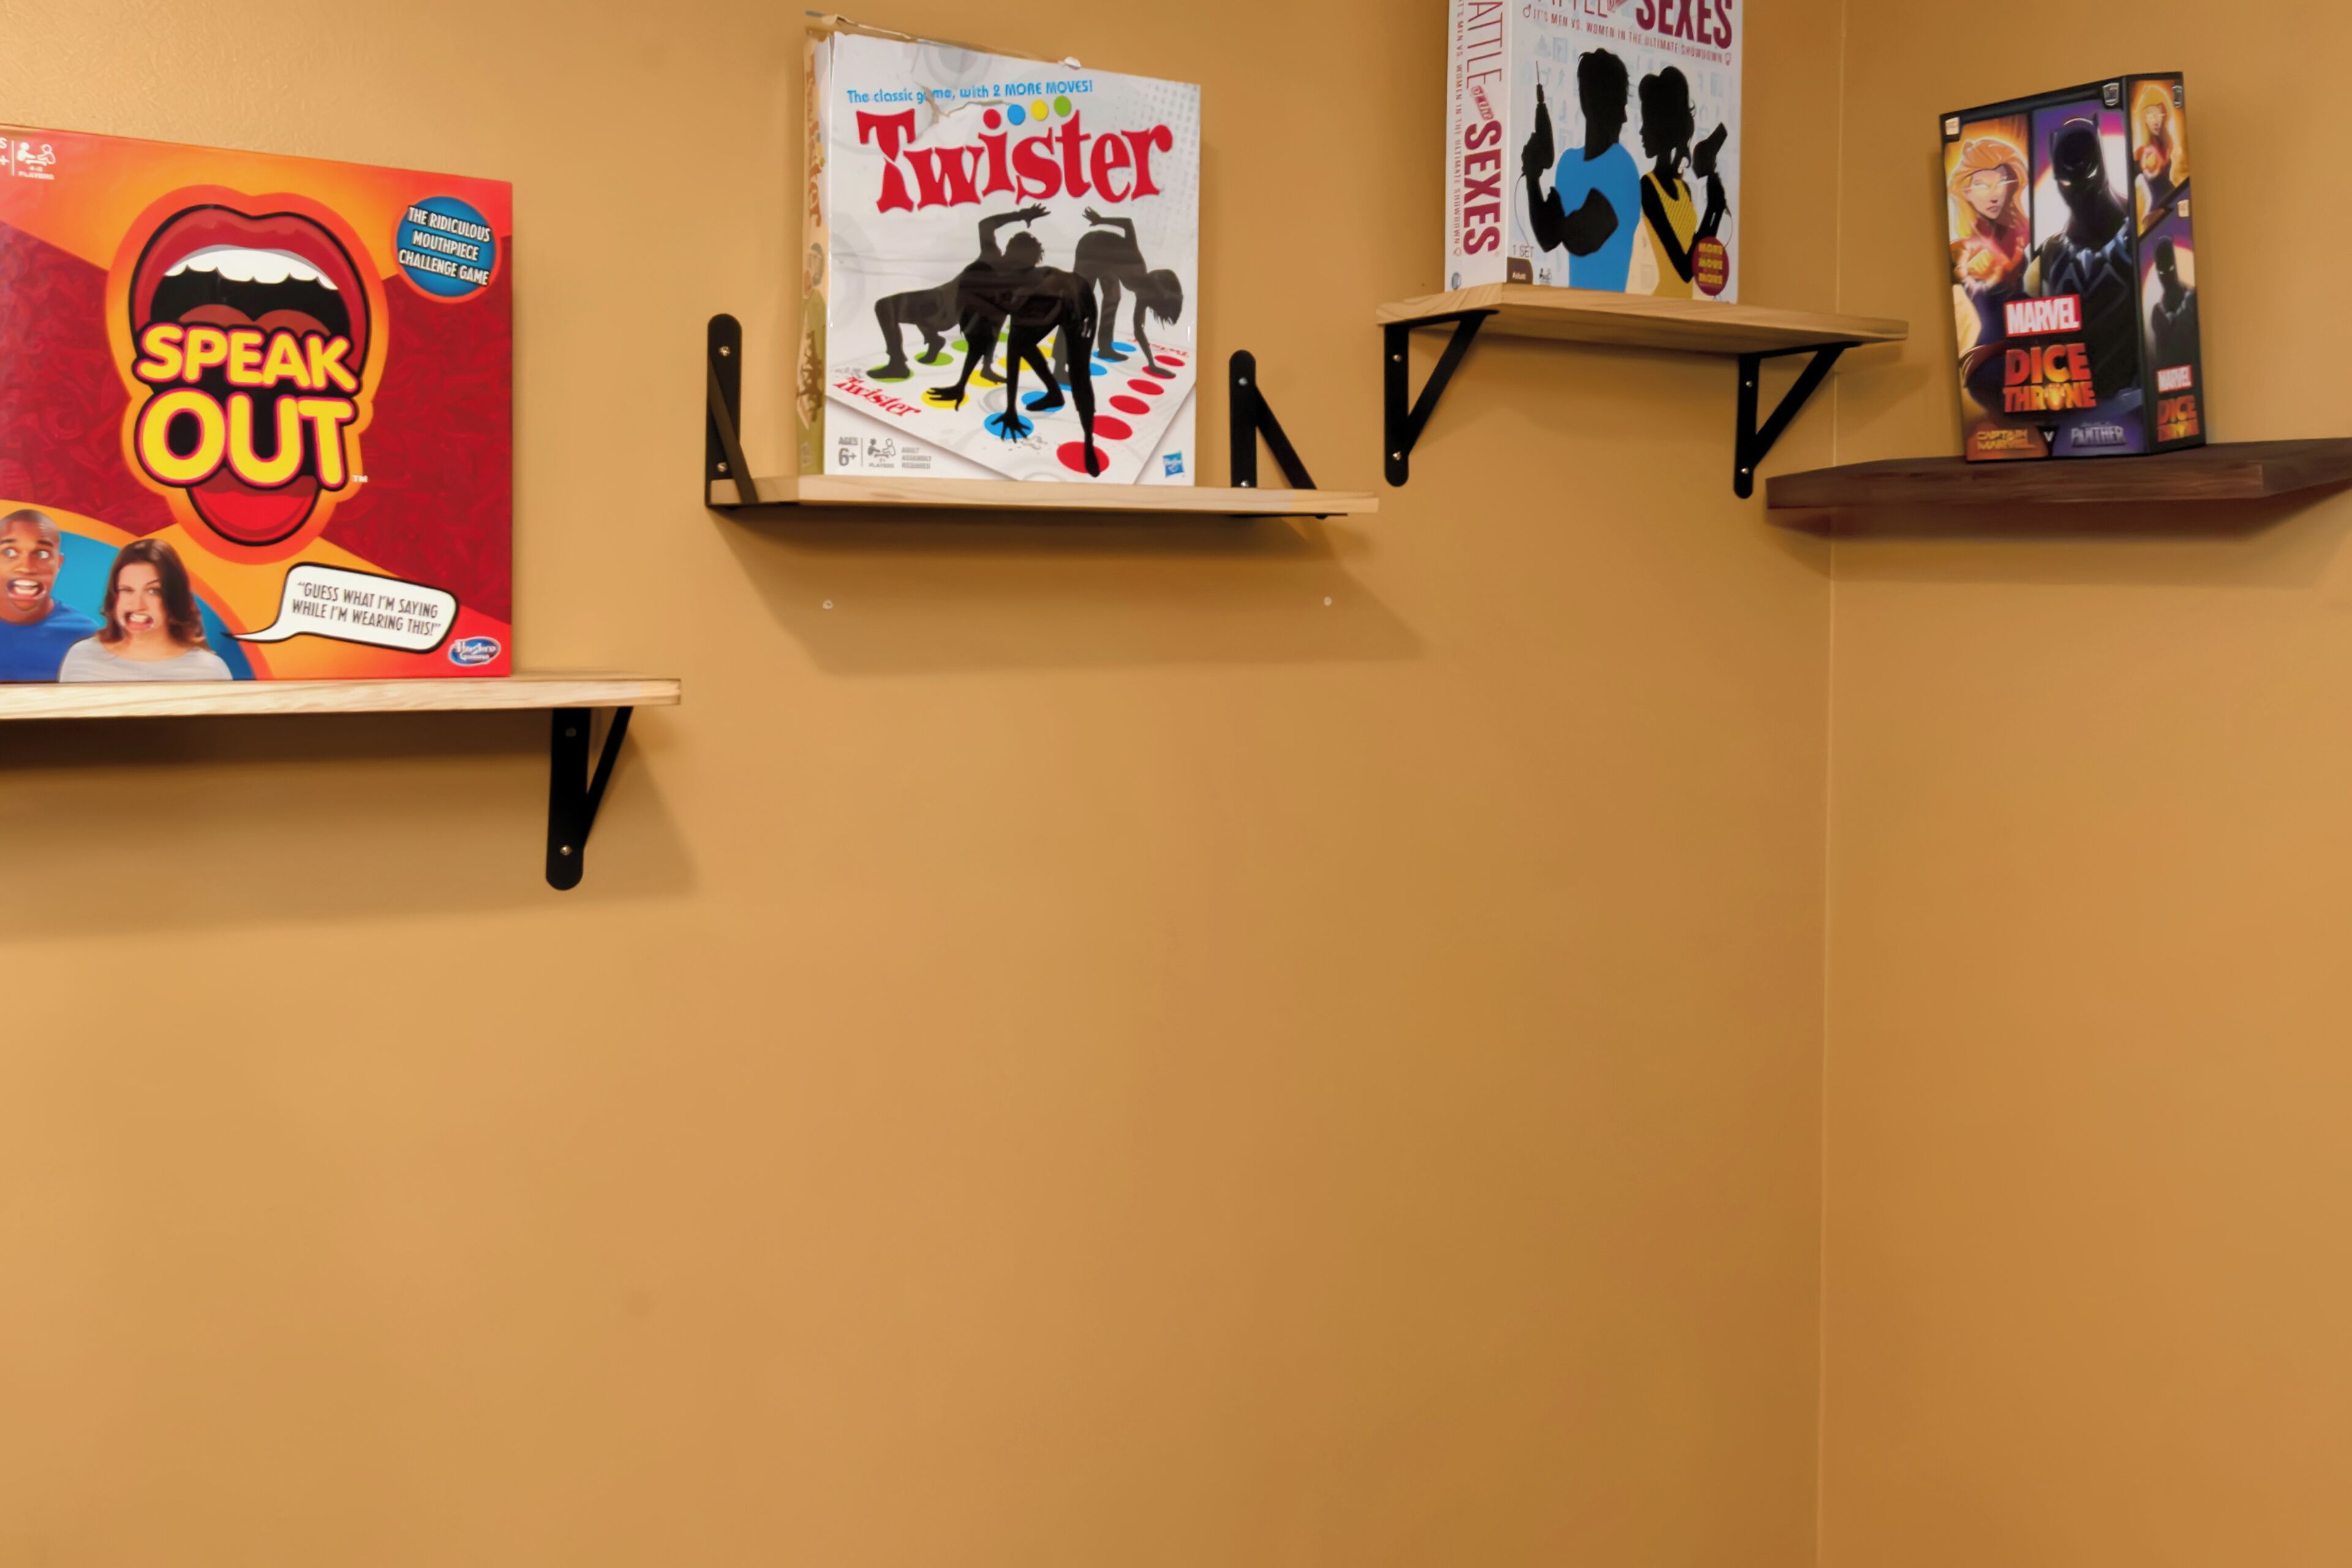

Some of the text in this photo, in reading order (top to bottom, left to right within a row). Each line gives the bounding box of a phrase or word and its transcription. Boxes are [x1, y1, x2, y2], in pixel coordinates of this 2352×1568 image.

[1533, 9, 1548, 22] IT'S
[1551, 13, 1568, 27] MEN
[1586, 21, 1615, 38] WOMEN
[1618, 29, 1626, 41] IN
[1629, 31, 1642, 44] THE
[1645, 36, 1678, 53] ULTIMATE
[1681, 44, 1722, 64] SHOWDOWN
[1636, 0, 1732, 49] SEXES
[1467, 0, 1503, 89] ATTLE
[847, 89, 869, 104] The
[874, 88, 913, 103] classic
[959, 84, 989, 99] with
[993, 84, 1001, 97] 2
[1005, 81, 1042, 97] MORE
[1046, 80, 1093, 94] MOVES!
[1455, 104, 1463, 115] IN
[856, 108, 1174, 214] Twister
[1463, 120, 1502, 255] SEXES
[407, 206, 491, 243] THE RIDICULOUS
[412, 230, 480, 261] MOUTHPIECE
[1520, 245, 1534, 258] SET
[399, 249, 489, 286] CHALLENGE GAME
[2006, 296, 2079, 334] MARVEL
[136, 323, 360, 393] SPEAK
[2005, 342, 2092, 386] DICE
[2158, 394, 2198, 426] DICE
[138, 387, 357, 488] OUT
[838, 437, 858, 445] AGES
[2043, 431, 2054, 442] V
[2070, 426, 2127, 447] PANTHER
[839, 448, 857, 466] 6+
[292, 598, 326, 619] WHILE
[330, 605, 349, 622] I'M
[352, 609, 404, 631] WEARING
[343, 589, 375, 608] WHAT
[377, 595, 395, 611] I'M
[398, 598, 439, 619] SAYING
